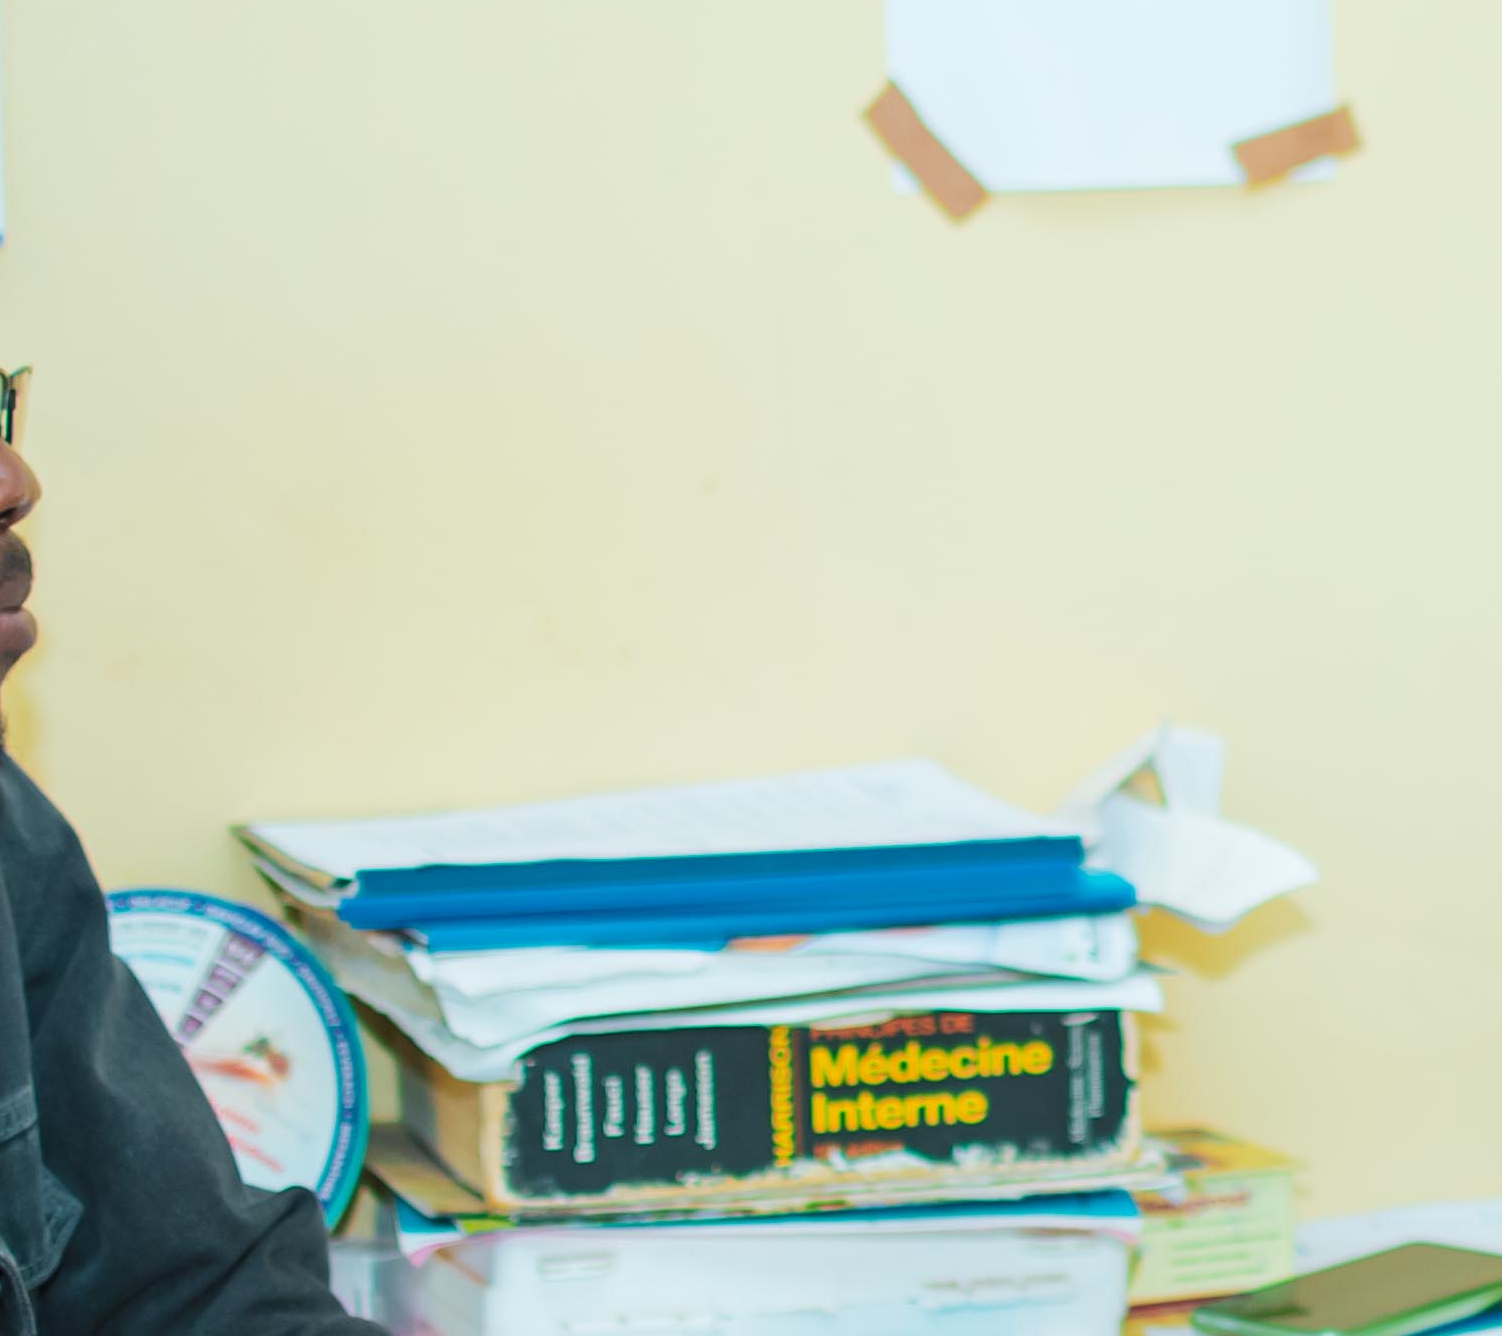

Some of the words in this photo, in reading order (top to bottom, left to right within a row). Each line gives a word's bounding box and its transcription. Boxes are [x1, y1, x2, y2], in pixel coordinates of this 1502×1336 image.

[940, 1013, 974, 1034] DE
[769, 1025, 794, 1167] HARRISON
[810, 1035, 1053, 1088] Médecine
[543, 1070, 564, 1151] Kasper
[571, 1052, 595, 1163] Braunwald
[602, 1075, 624, 1138] Fauci
[634, 1064, 655, 1145] Hauser
[664, 1067, 687, 1136] Longo
[694, 1050, 716, 1150] Jameson
[811, 1090, 988, 1134] Interne
